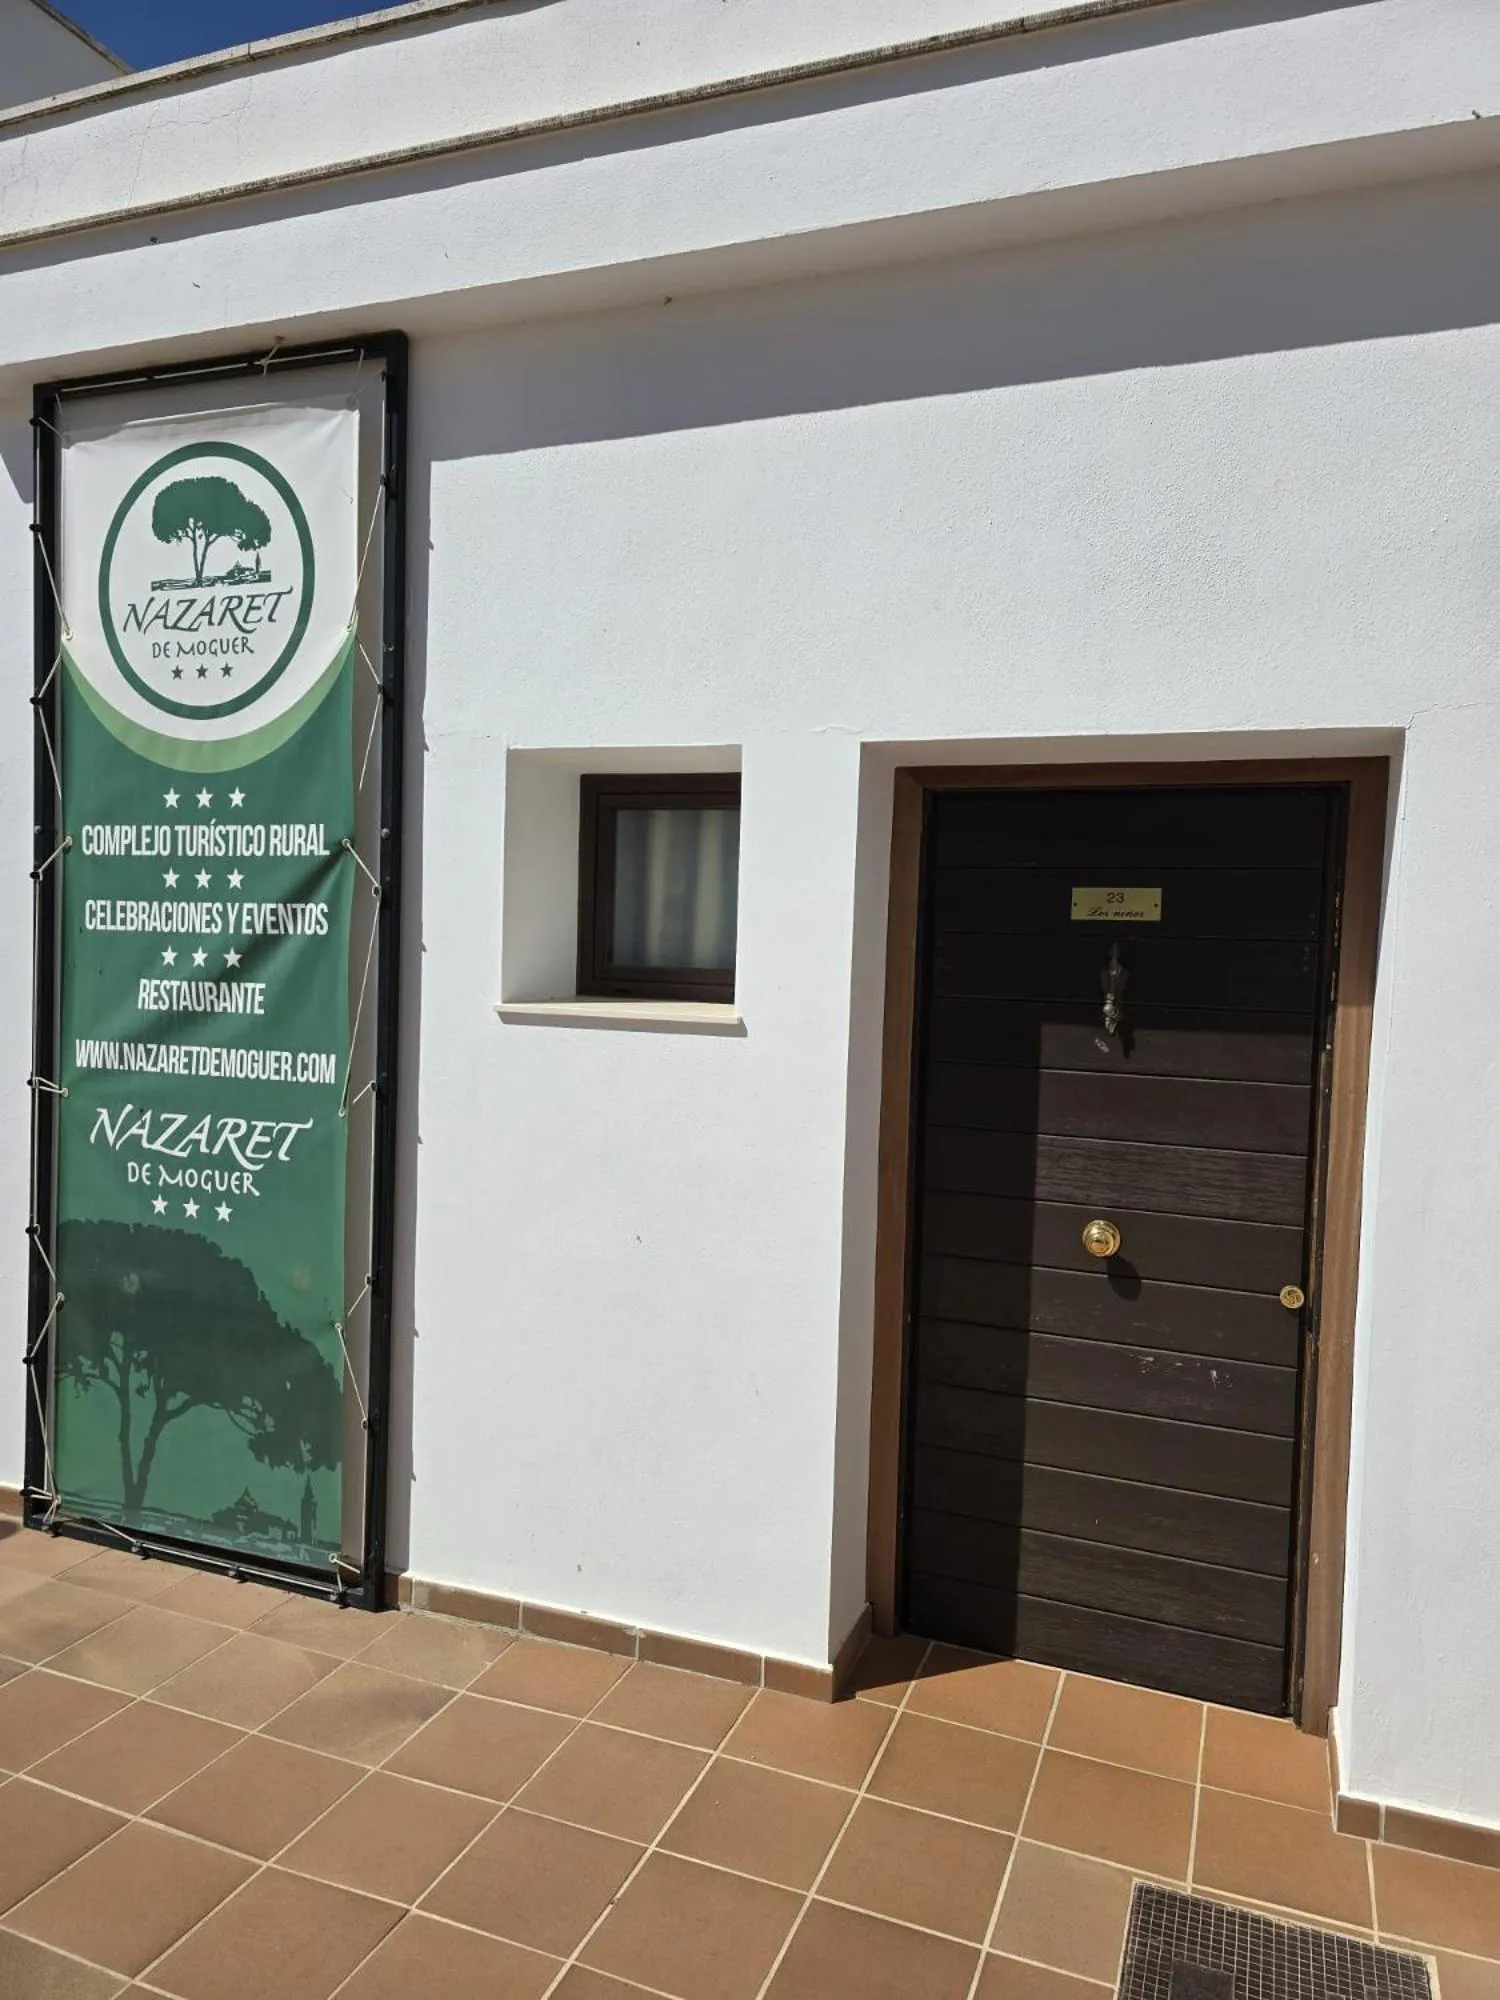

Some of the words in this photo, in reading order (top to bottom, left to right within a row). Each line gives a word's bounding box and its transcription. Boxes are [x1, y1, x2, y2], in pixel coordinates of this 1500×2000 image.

[123, 586, 293, 634] NAZARET
[152, 641, 171, 658] DE
[176, 636, 255, 659] MOGUER
[82, 825, 171, 856] COMPLEJO
[174, 818, 266, 857] TURÍSTICO
[269, 823, 330, 856] RURAL
[1106, 892, 1125, 904] 23
[85, 900, 222, 934] CELEBRACIONES
[227, 902, 240, 934] Y
[242, 902, 328, 935] EVENTOS
[137, 978, 266, 1015] RESTAURANTE
[75, 1039, 337, 1085] WWW.NAZARETDEMOGUER.COM
[90, 1103, 314, 1171] NAZARET
[127, 1161, 151, 1185] DE
[158, 1164, 260, 1197] MOGUER
